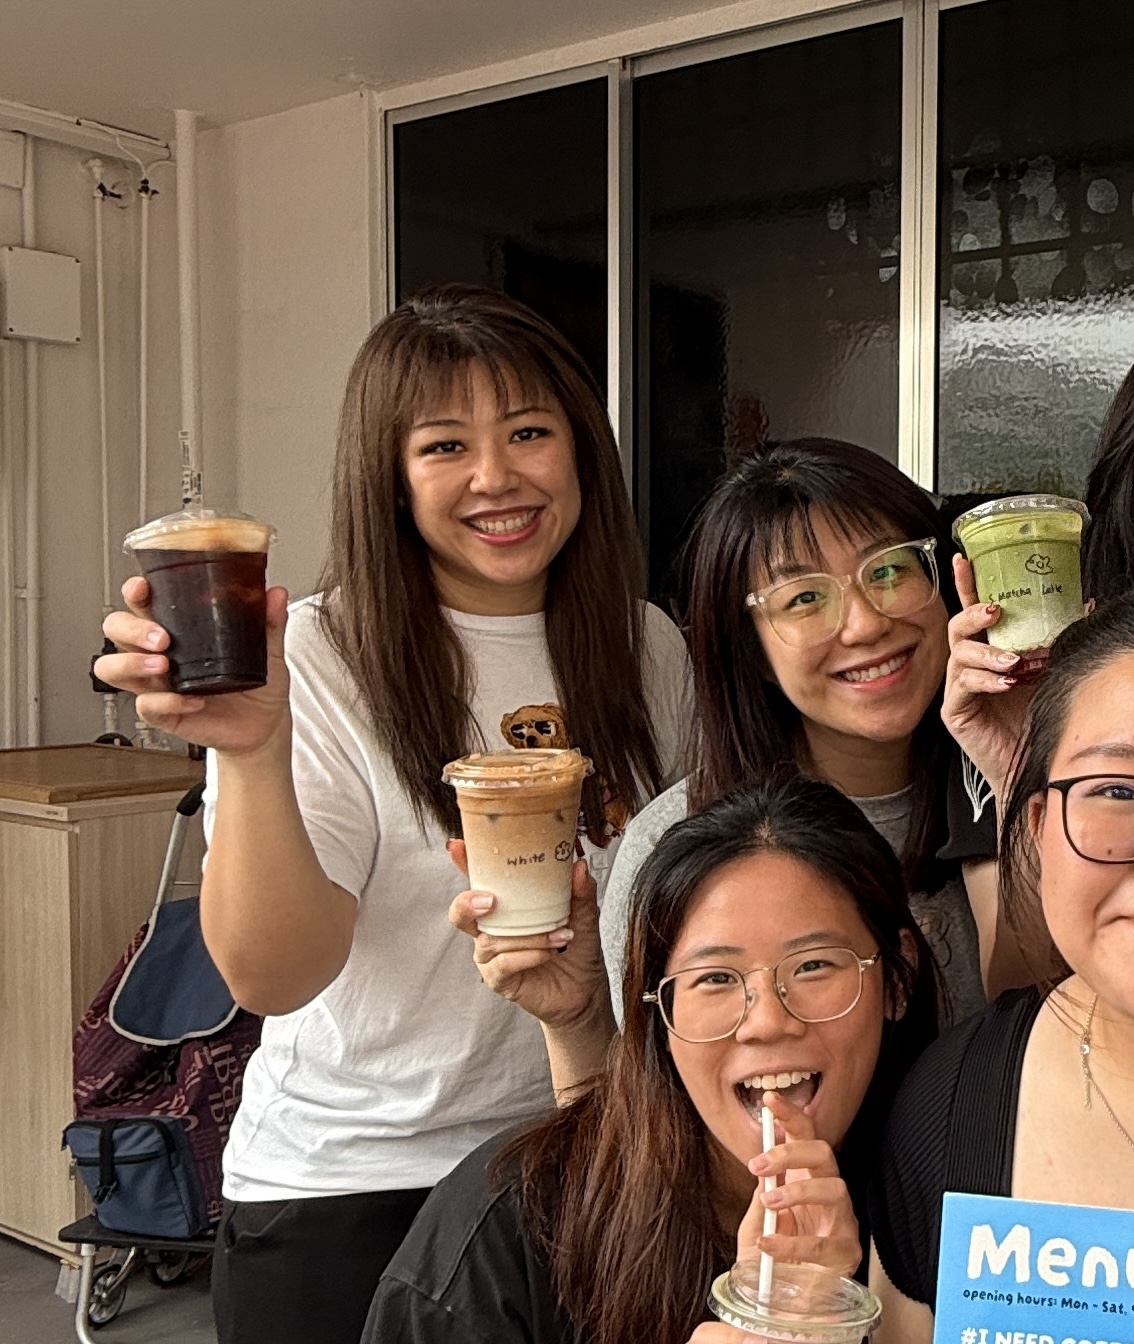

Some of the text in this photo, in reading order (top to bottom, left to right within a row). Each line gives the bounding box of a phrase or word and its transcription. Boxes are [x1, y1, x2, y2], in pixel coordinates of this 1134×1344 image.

[963, 1289, 1013, 1305] opening
[1017, 1293, 1057, 1307] hours:
[1061, 1297, 1088, 1310] Mon
